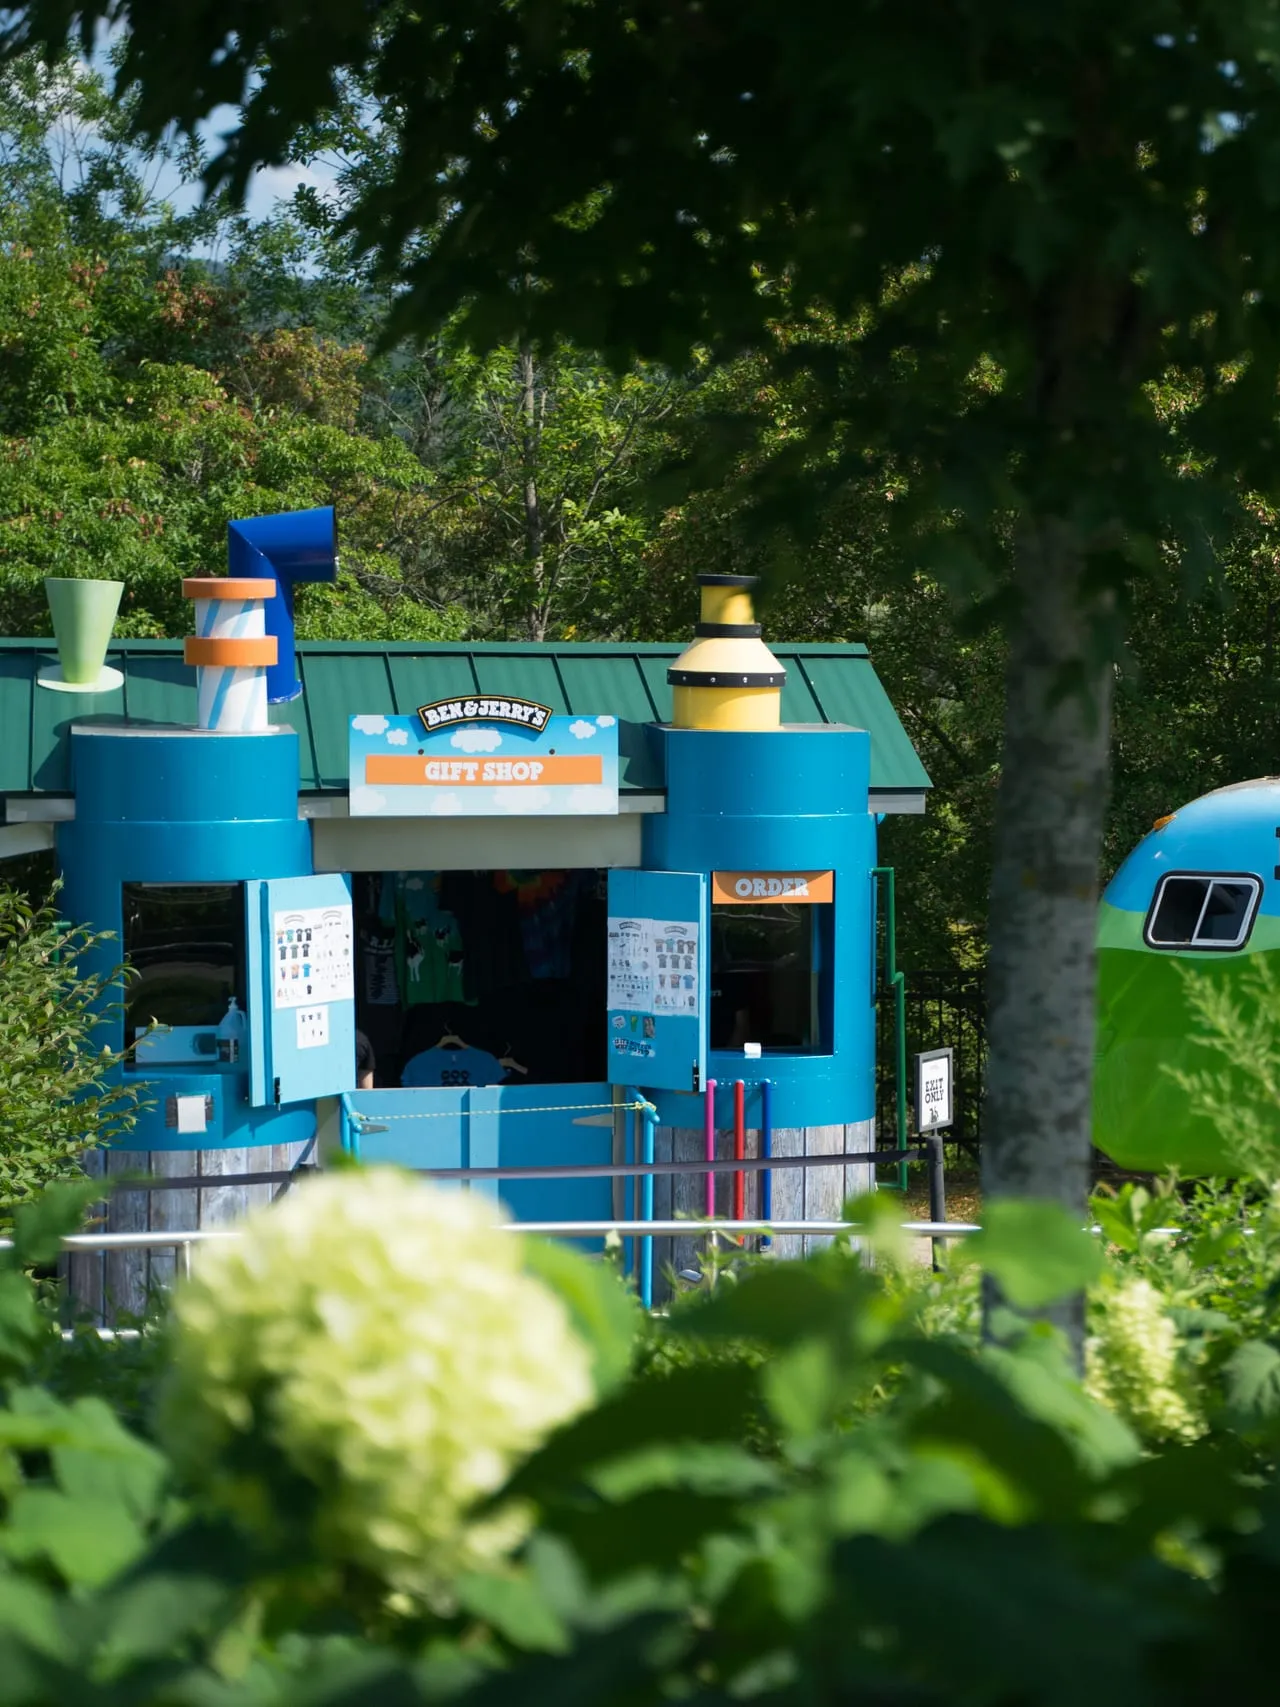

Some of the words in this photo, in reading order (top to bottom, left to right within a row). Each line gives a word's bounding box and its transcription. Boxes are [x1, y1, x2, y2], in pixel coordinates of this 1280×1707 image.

[425, 701, 462, 726] BEN
[478, 700, 546, 727] JERRY'S
[425, 762, 479, 781] GIFT
[482, 762, 544, 781] SHOP
[735, 878, 809, 897] ORDER
[925, 1077, 944, 1092] EXIT
[924, 1089, 945, 1104] ONLY
